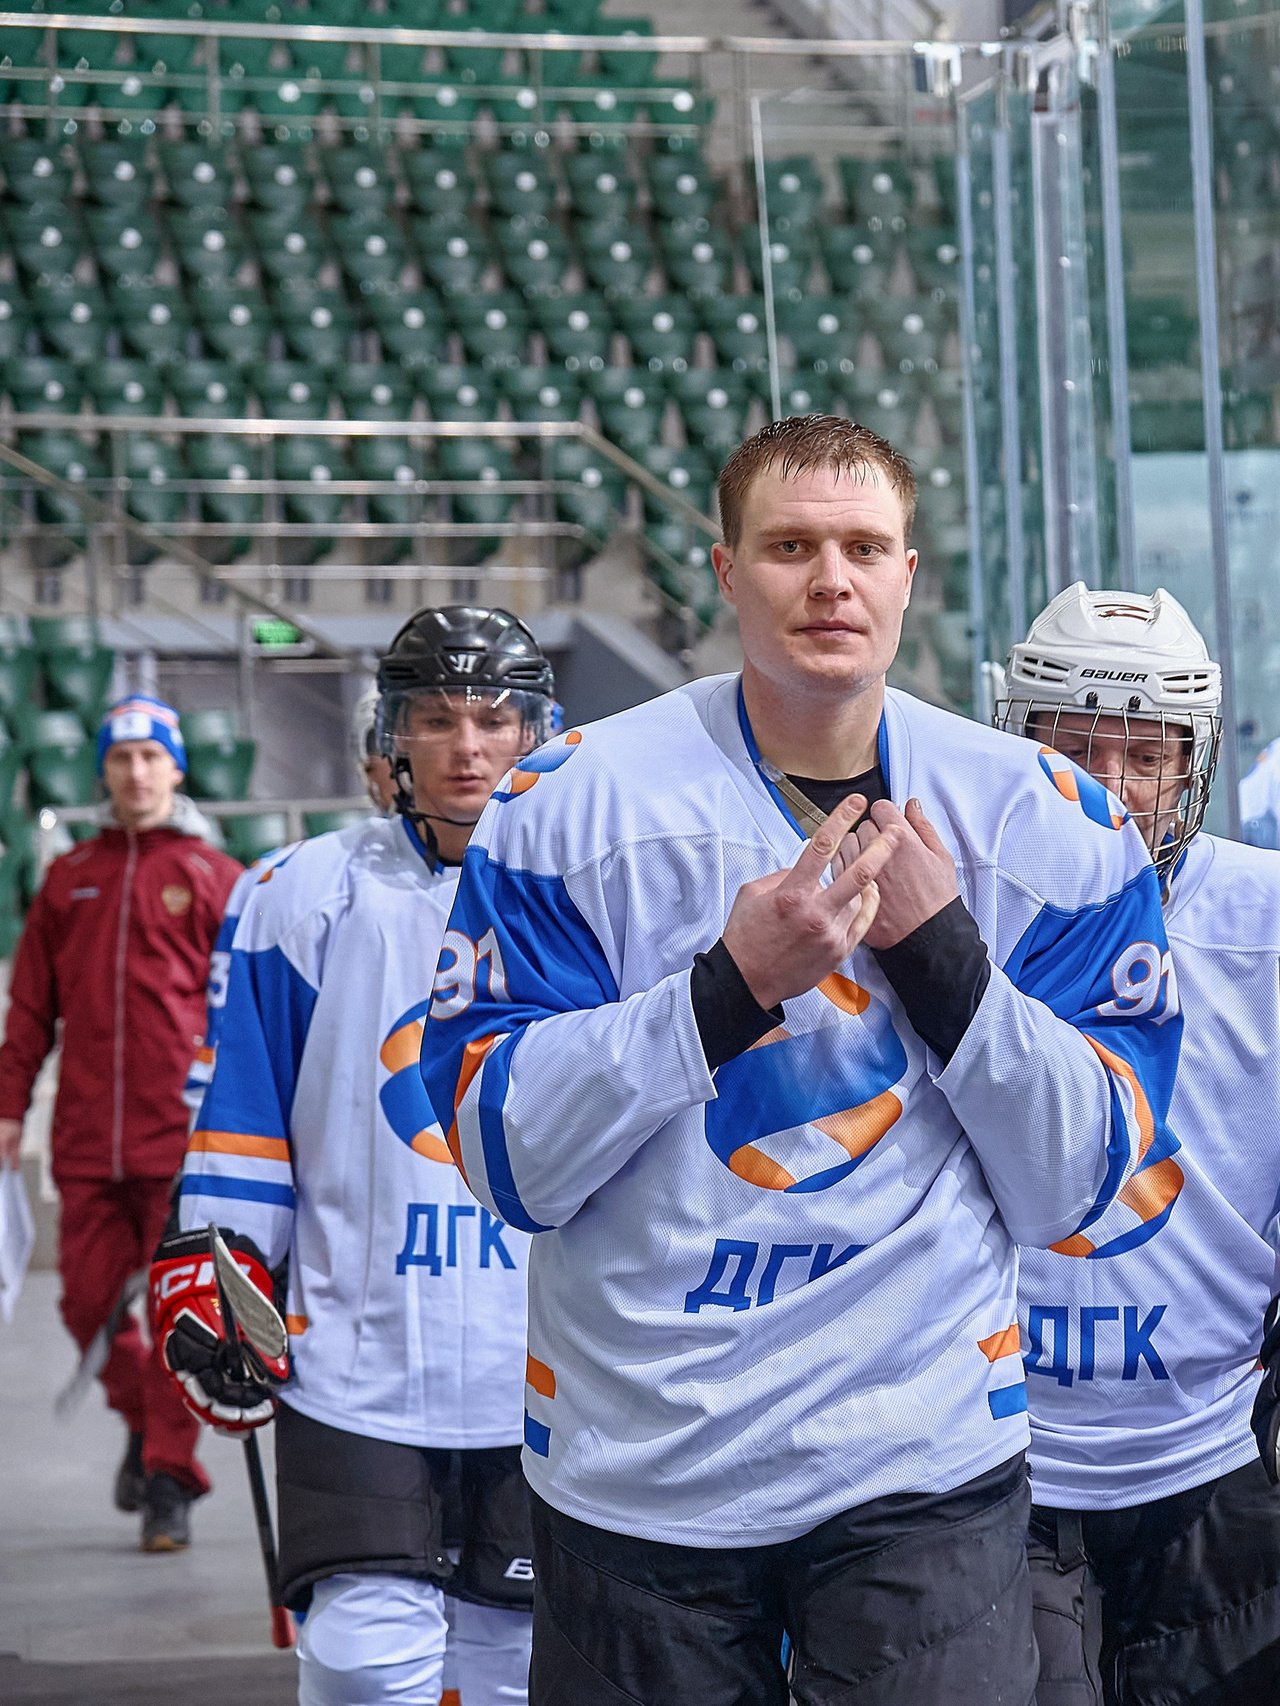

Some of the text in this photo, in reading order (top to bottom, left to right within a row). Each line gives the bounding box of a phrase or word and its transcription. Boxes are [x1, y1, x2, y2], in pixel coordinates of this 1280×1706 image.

[1079, 668, 1149, 683] BAUER
[430, 925, 513, 1020] 91
[1096, 940, 1180, 1027] 91
[395, 1202, 517, 1277] ДГК
[1022, 1304, 1170, 1388] ДГК
